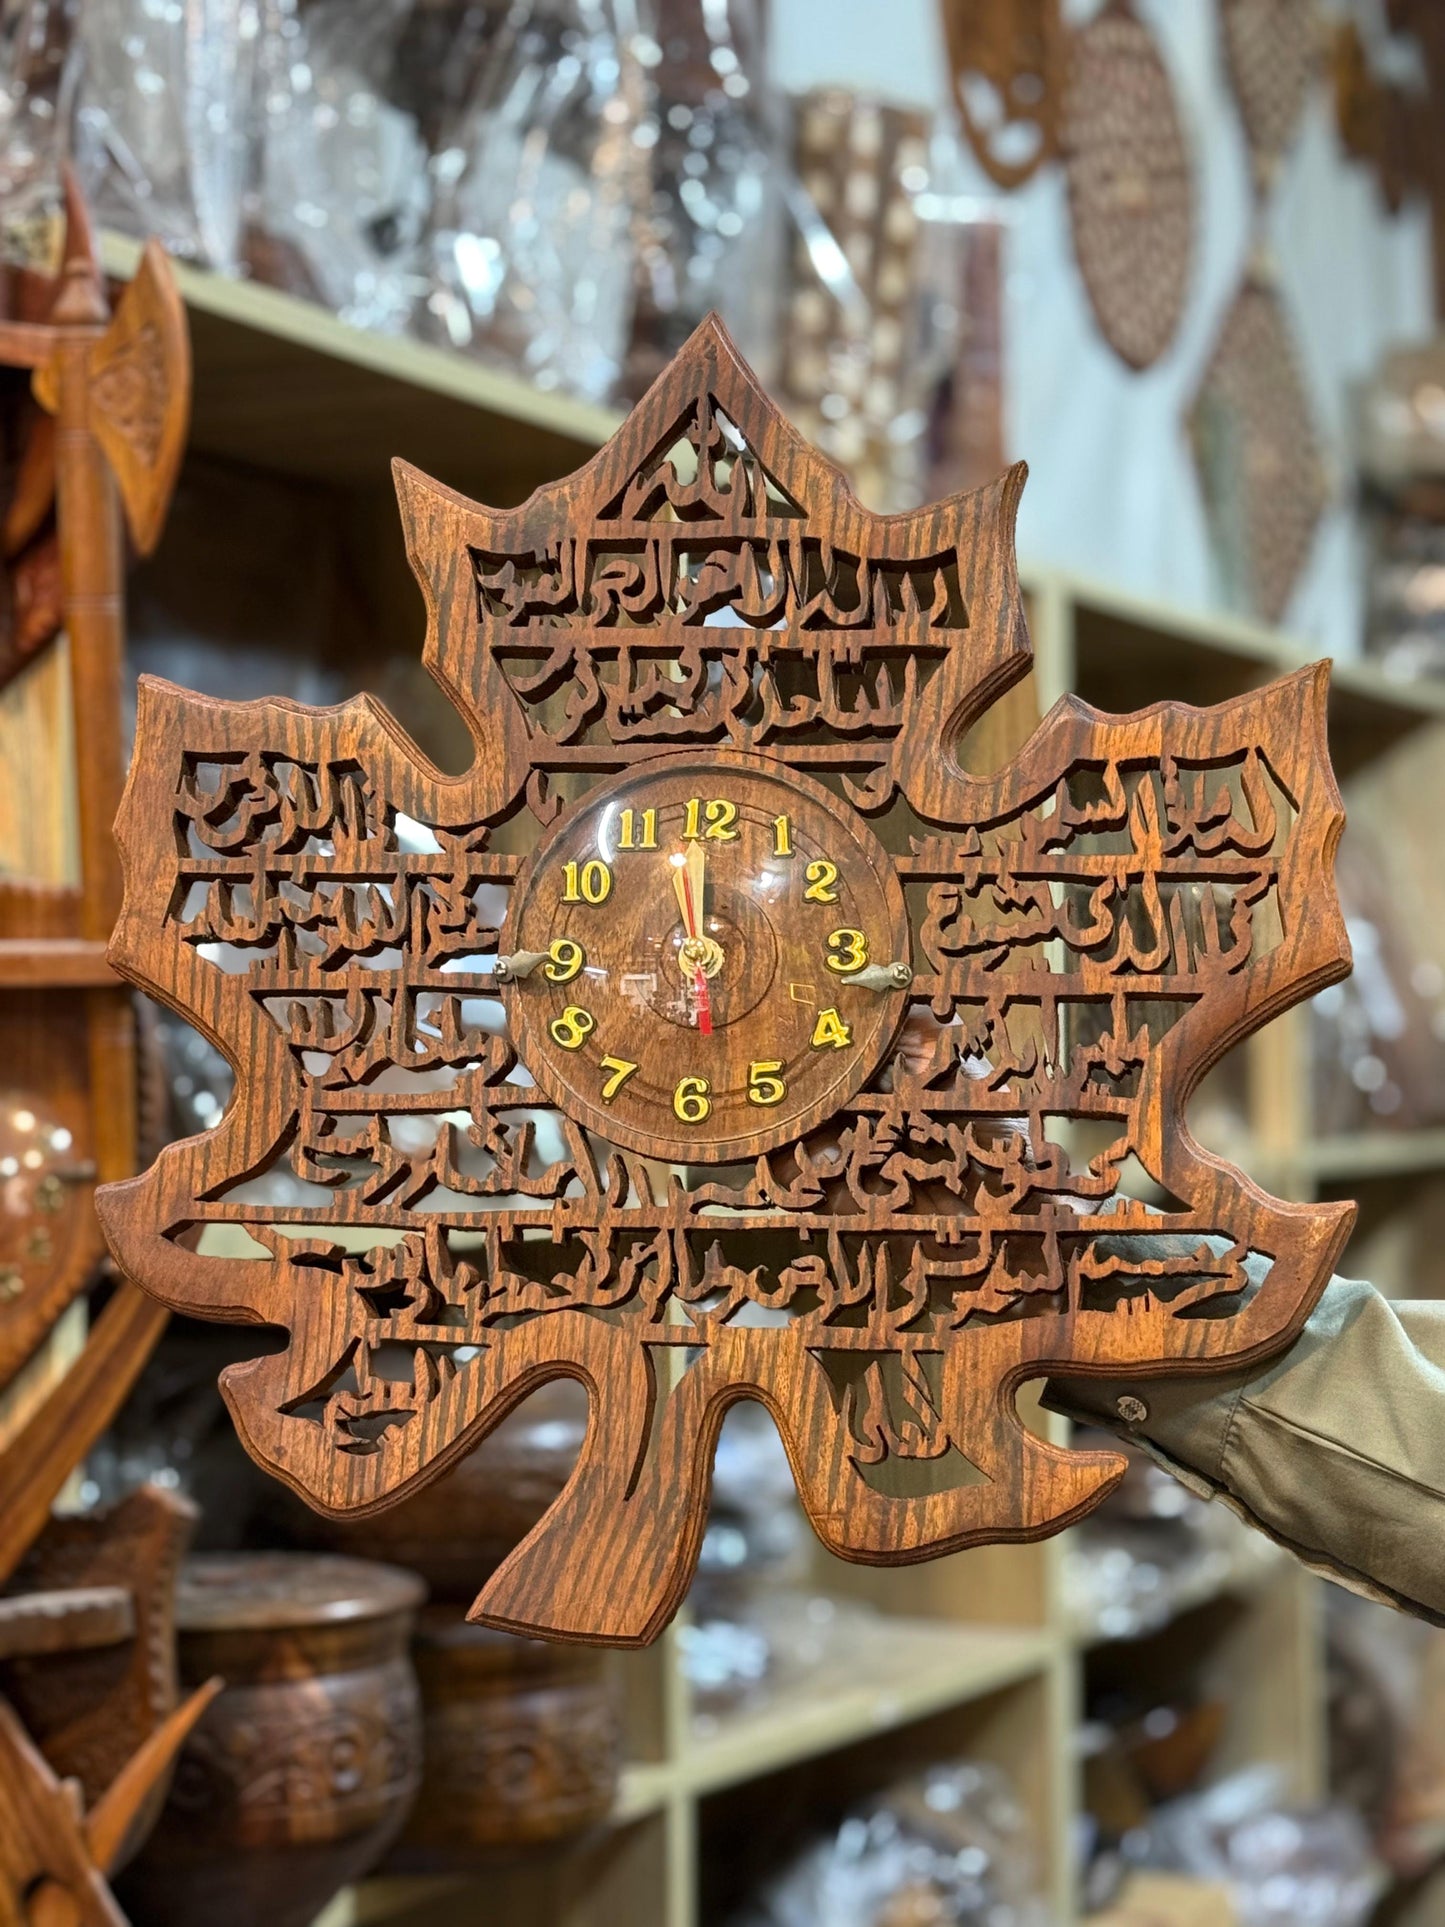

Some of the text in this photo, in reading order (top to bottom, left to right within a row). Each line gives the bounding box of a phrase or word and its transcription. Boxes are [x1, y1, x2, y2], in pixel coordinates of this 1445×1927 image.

[617, 808, 659, 850] 11
[683, 798, 739, 842] 12
[772, 814, 795, 858] 1
[561, 859, 613, 905] 10
[803, 858, 840, 904] 2
[543, 938, 586, 984] 9
[825, 927, 870, 973] 3
[549, 1004, 596, 1051] 8
[810, 1007, 853, 1050] 4
[600, 1054, 639, 1104] 7
[673, 1076, 712, 1124] 6
[747, 1058, 786, 1107] 5
